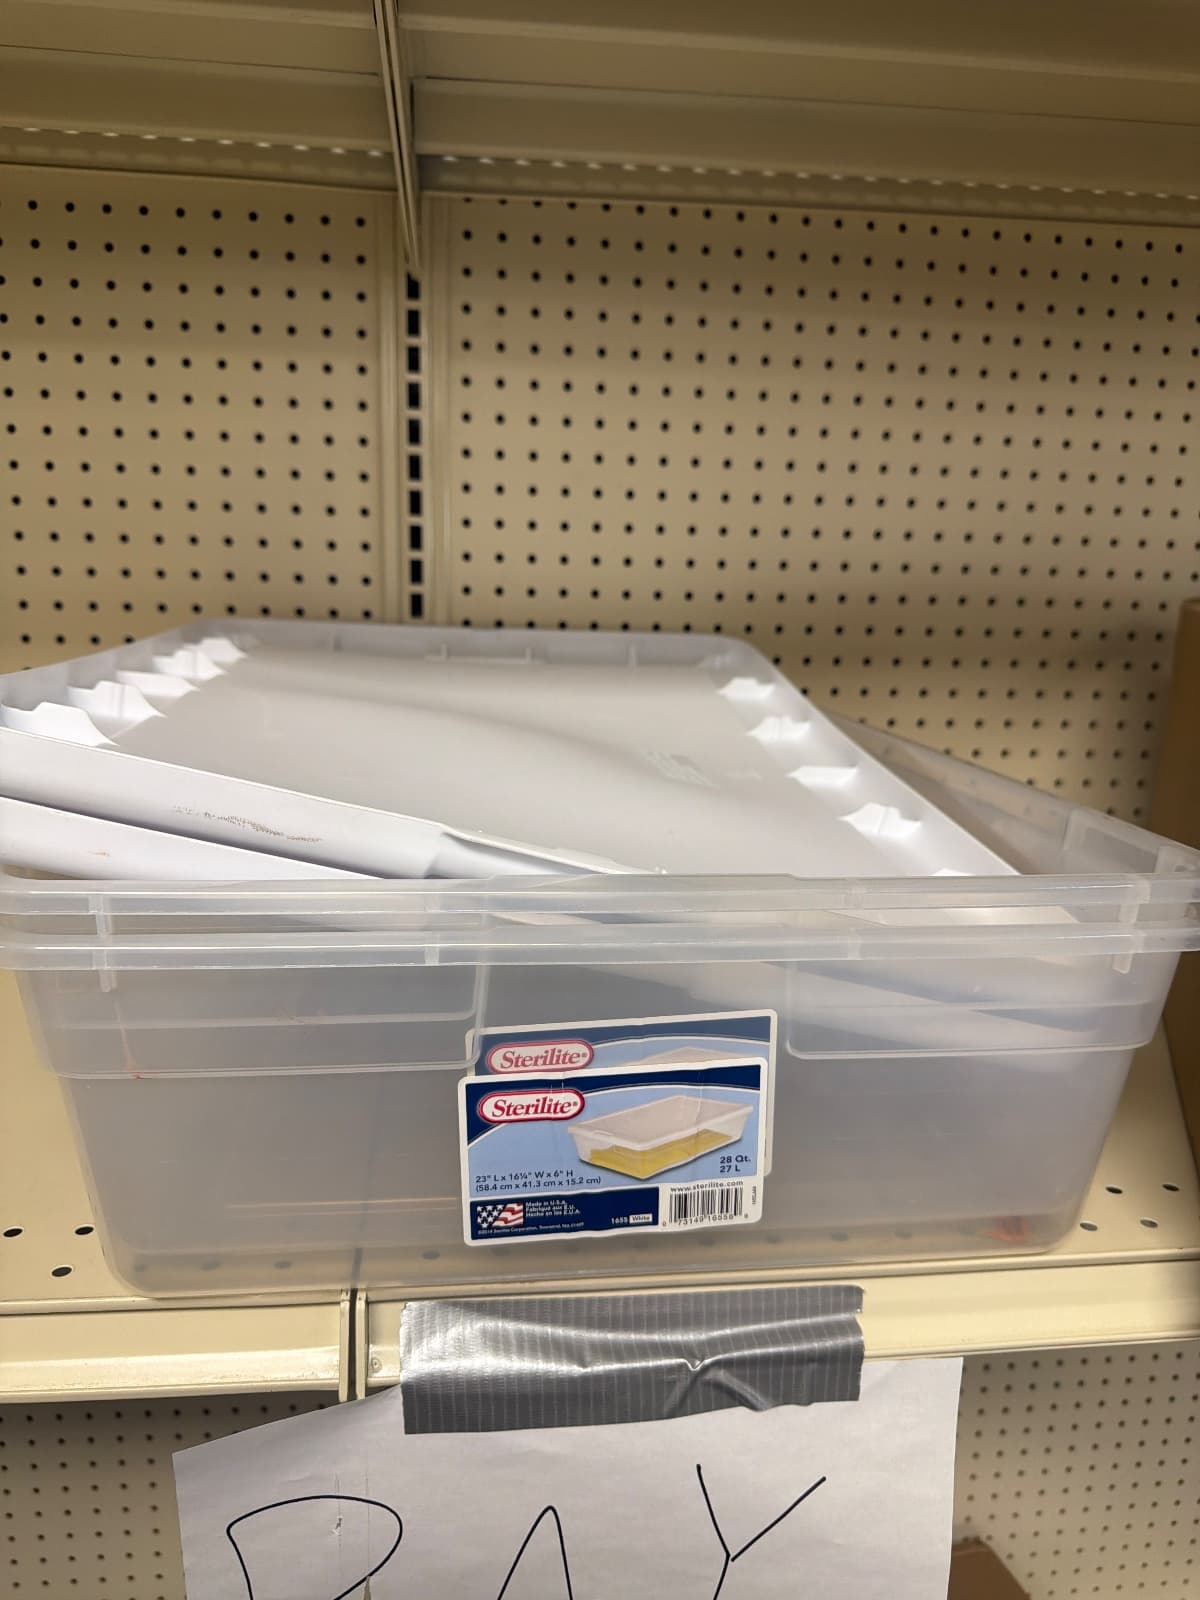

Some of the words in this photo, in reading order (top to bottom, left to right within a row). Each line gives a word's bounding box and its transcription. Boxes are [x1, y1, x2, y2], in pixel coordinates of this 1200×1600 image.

[719, 1155, 732, 1165] 28
[734, 1154, 752, 1164] Qt.
[719, 1164, 732, 1174] 27
[734, 1163, 741, 1173] L
[475, 1174, 491, 1183] 23"
[493, 1173, 499, 1182] L
[534, 1171, 544, 1179] W
[566, 1169, 574, 1177] H
[475, 1183, 498, 1192] (58.4
[522, 1180, 540, 1188] 41.3
[566, 1176, 584, 1186] 15.2
[585, 1175, 601, 1184] cm)
[669, 1180, 744, 1192] www.sterilite.com
